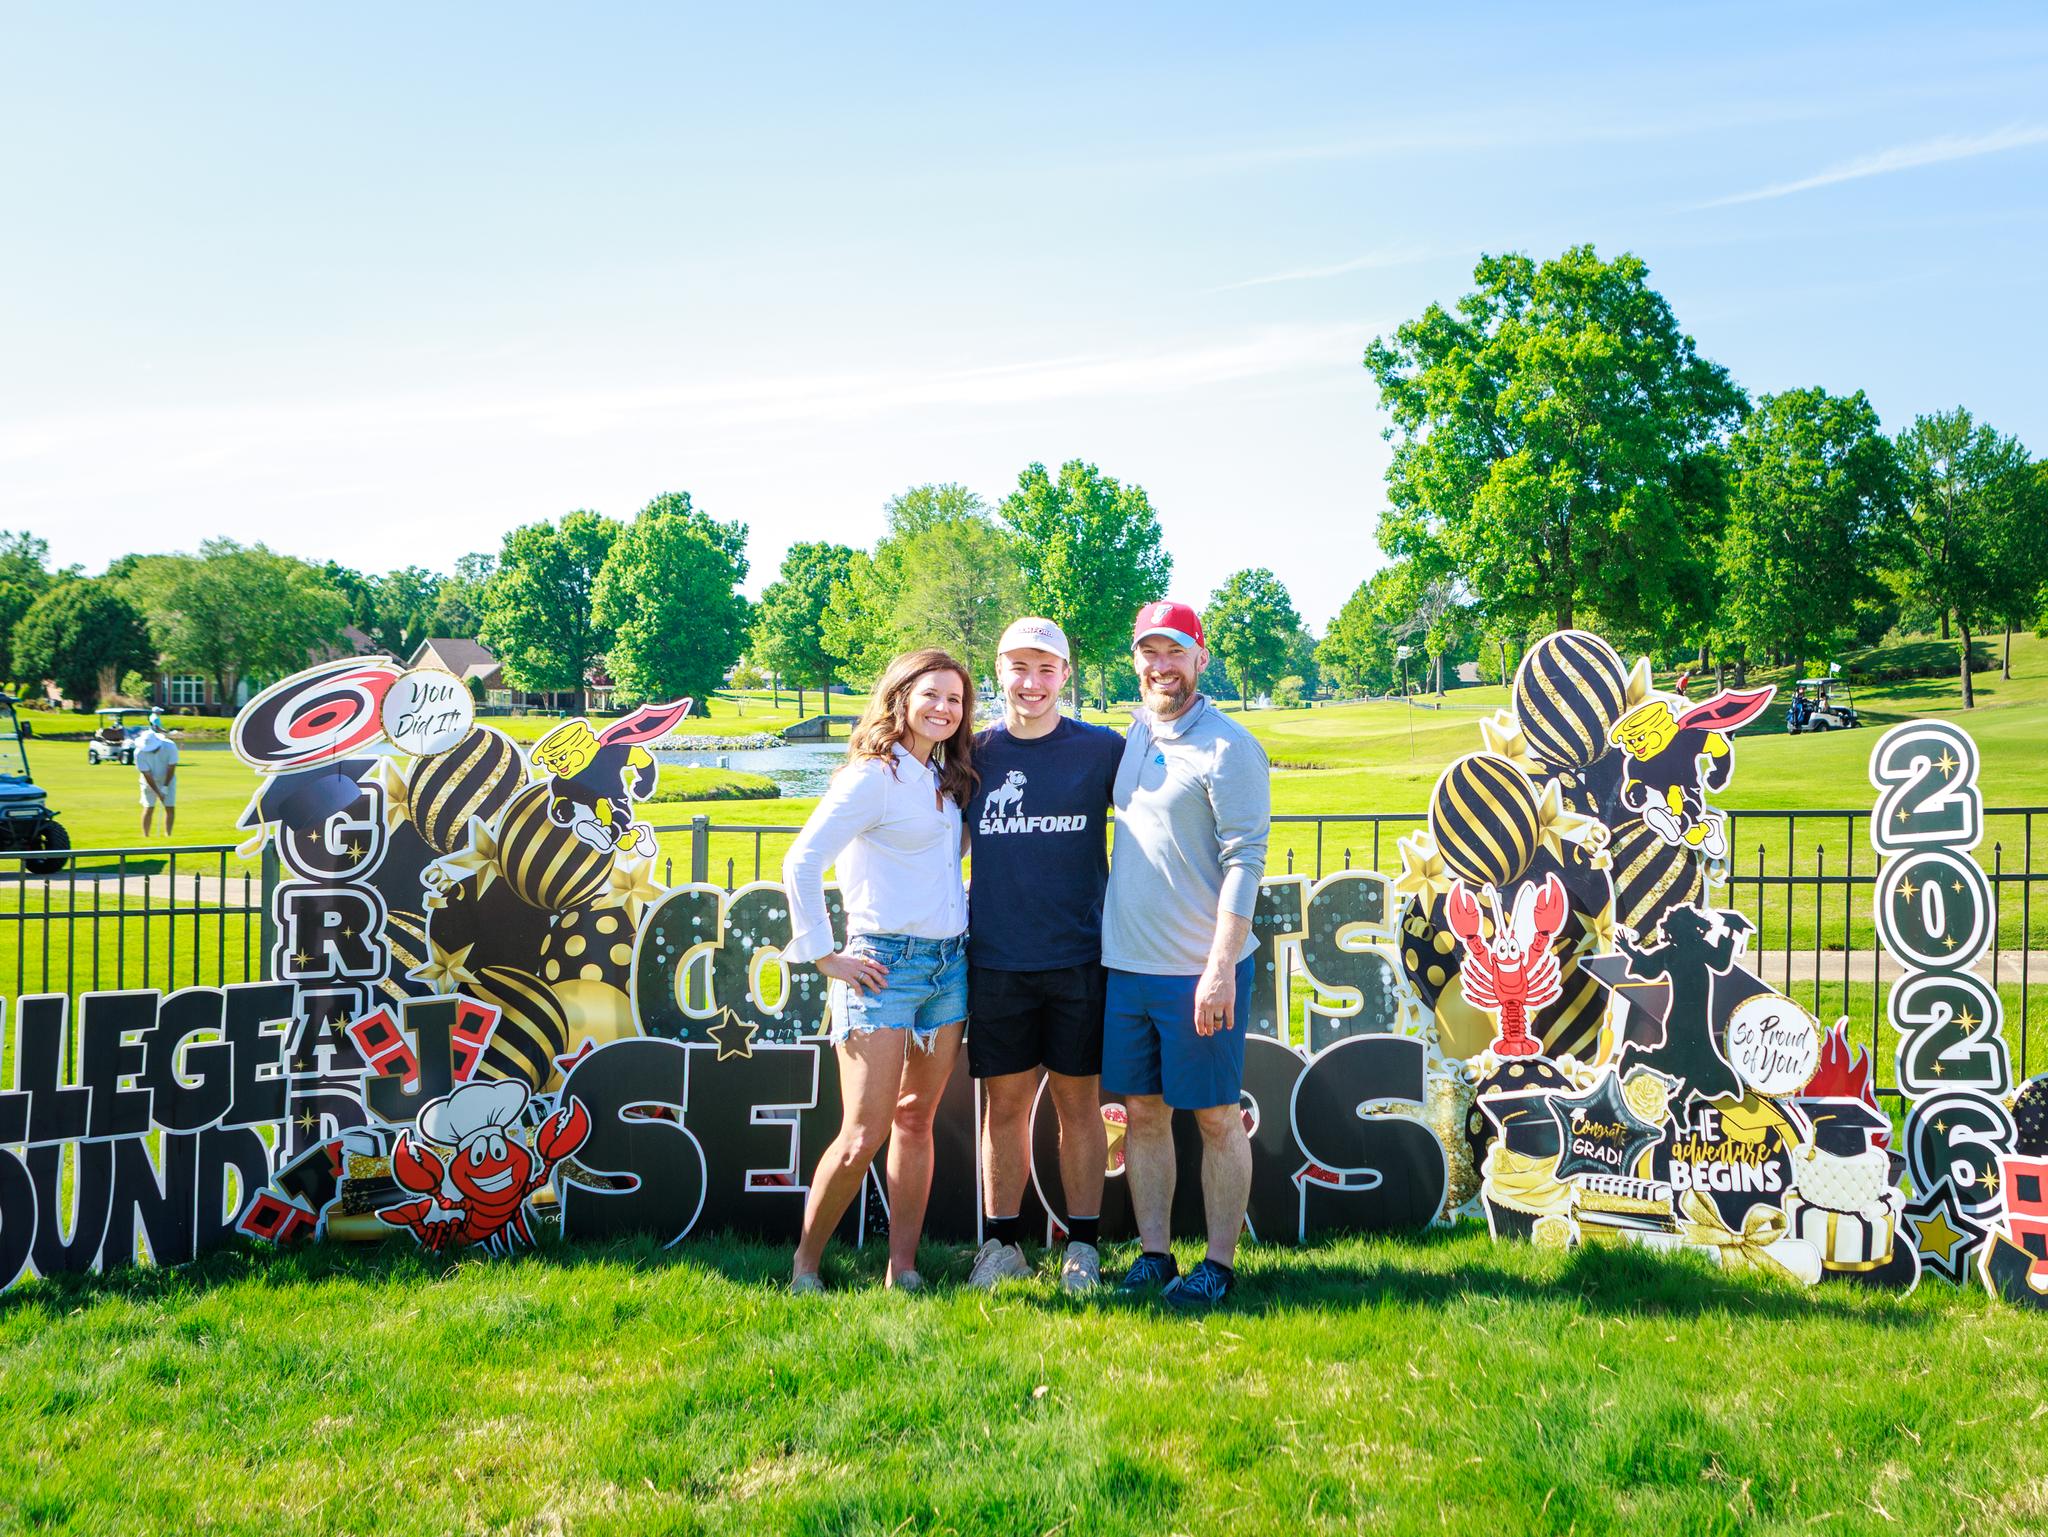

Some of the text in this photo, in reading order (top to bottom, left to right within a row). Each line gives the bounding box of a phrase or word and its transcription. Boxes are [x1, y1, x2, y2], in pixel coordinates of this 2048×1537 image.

[411, 682, 453, 713] You
[394, 709, 461, 738] Did It!
[979, 814, 1087, 835] SAMFORD
[1872, 720, 2018, 1230] 2026
[1733, 1015, 1810, 1050] So Proud
[1742, 1045, 1810, 1084] of You!
[1572, 1138, 1623, 1166] GRAD!
[1671, 1132, 1771, 1169] adventure
[1668, 1159, 1782, 1193] BEGINS
